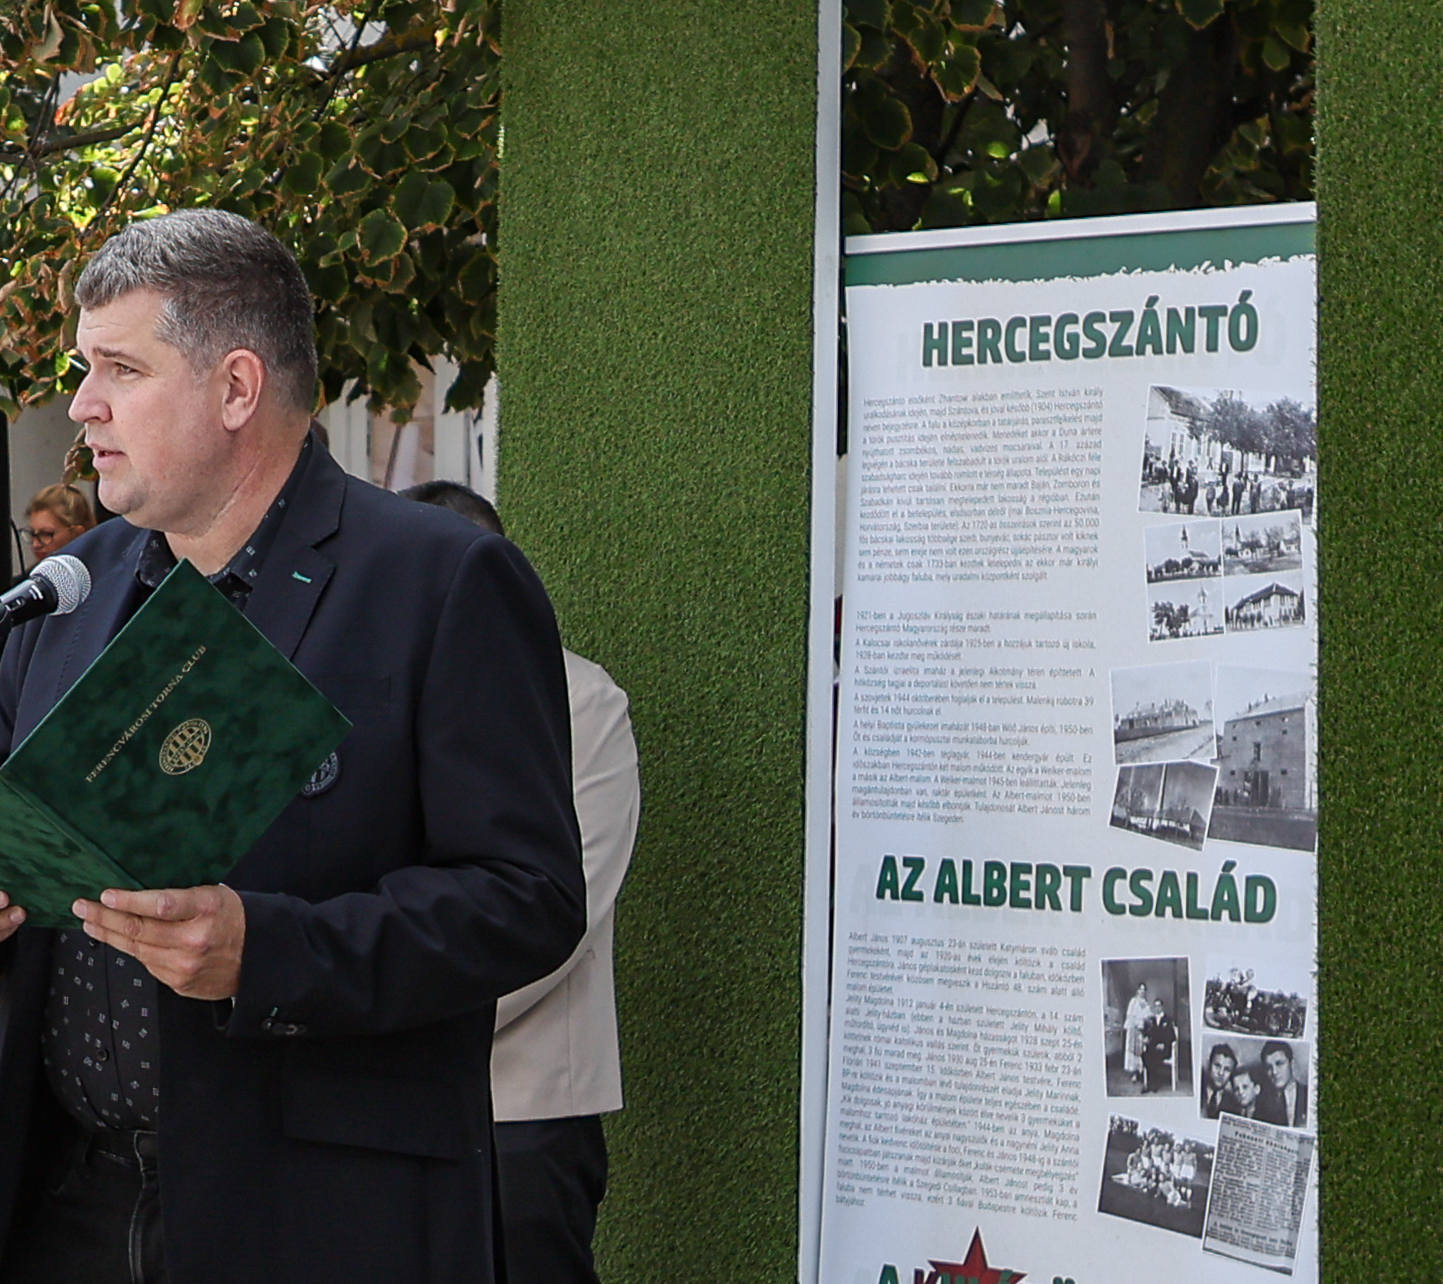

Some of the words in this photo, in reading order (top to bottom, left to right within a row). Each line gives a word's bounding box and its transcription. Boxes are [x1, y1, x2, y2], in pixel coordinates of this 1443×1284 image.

[923, 289, 1259, 367] HERCEGSZÁNTÓ
[85, 707, 152, 783] FERENCVÁROSI
[150, 674, 183, 709] TORNA
[181, 645, 207, 673] CLUB
[876, 855, 926, 902] AZ
[933, 858, 1092, 912] ALBERT
[1102, 859, 1277, 923] CSALÁD
